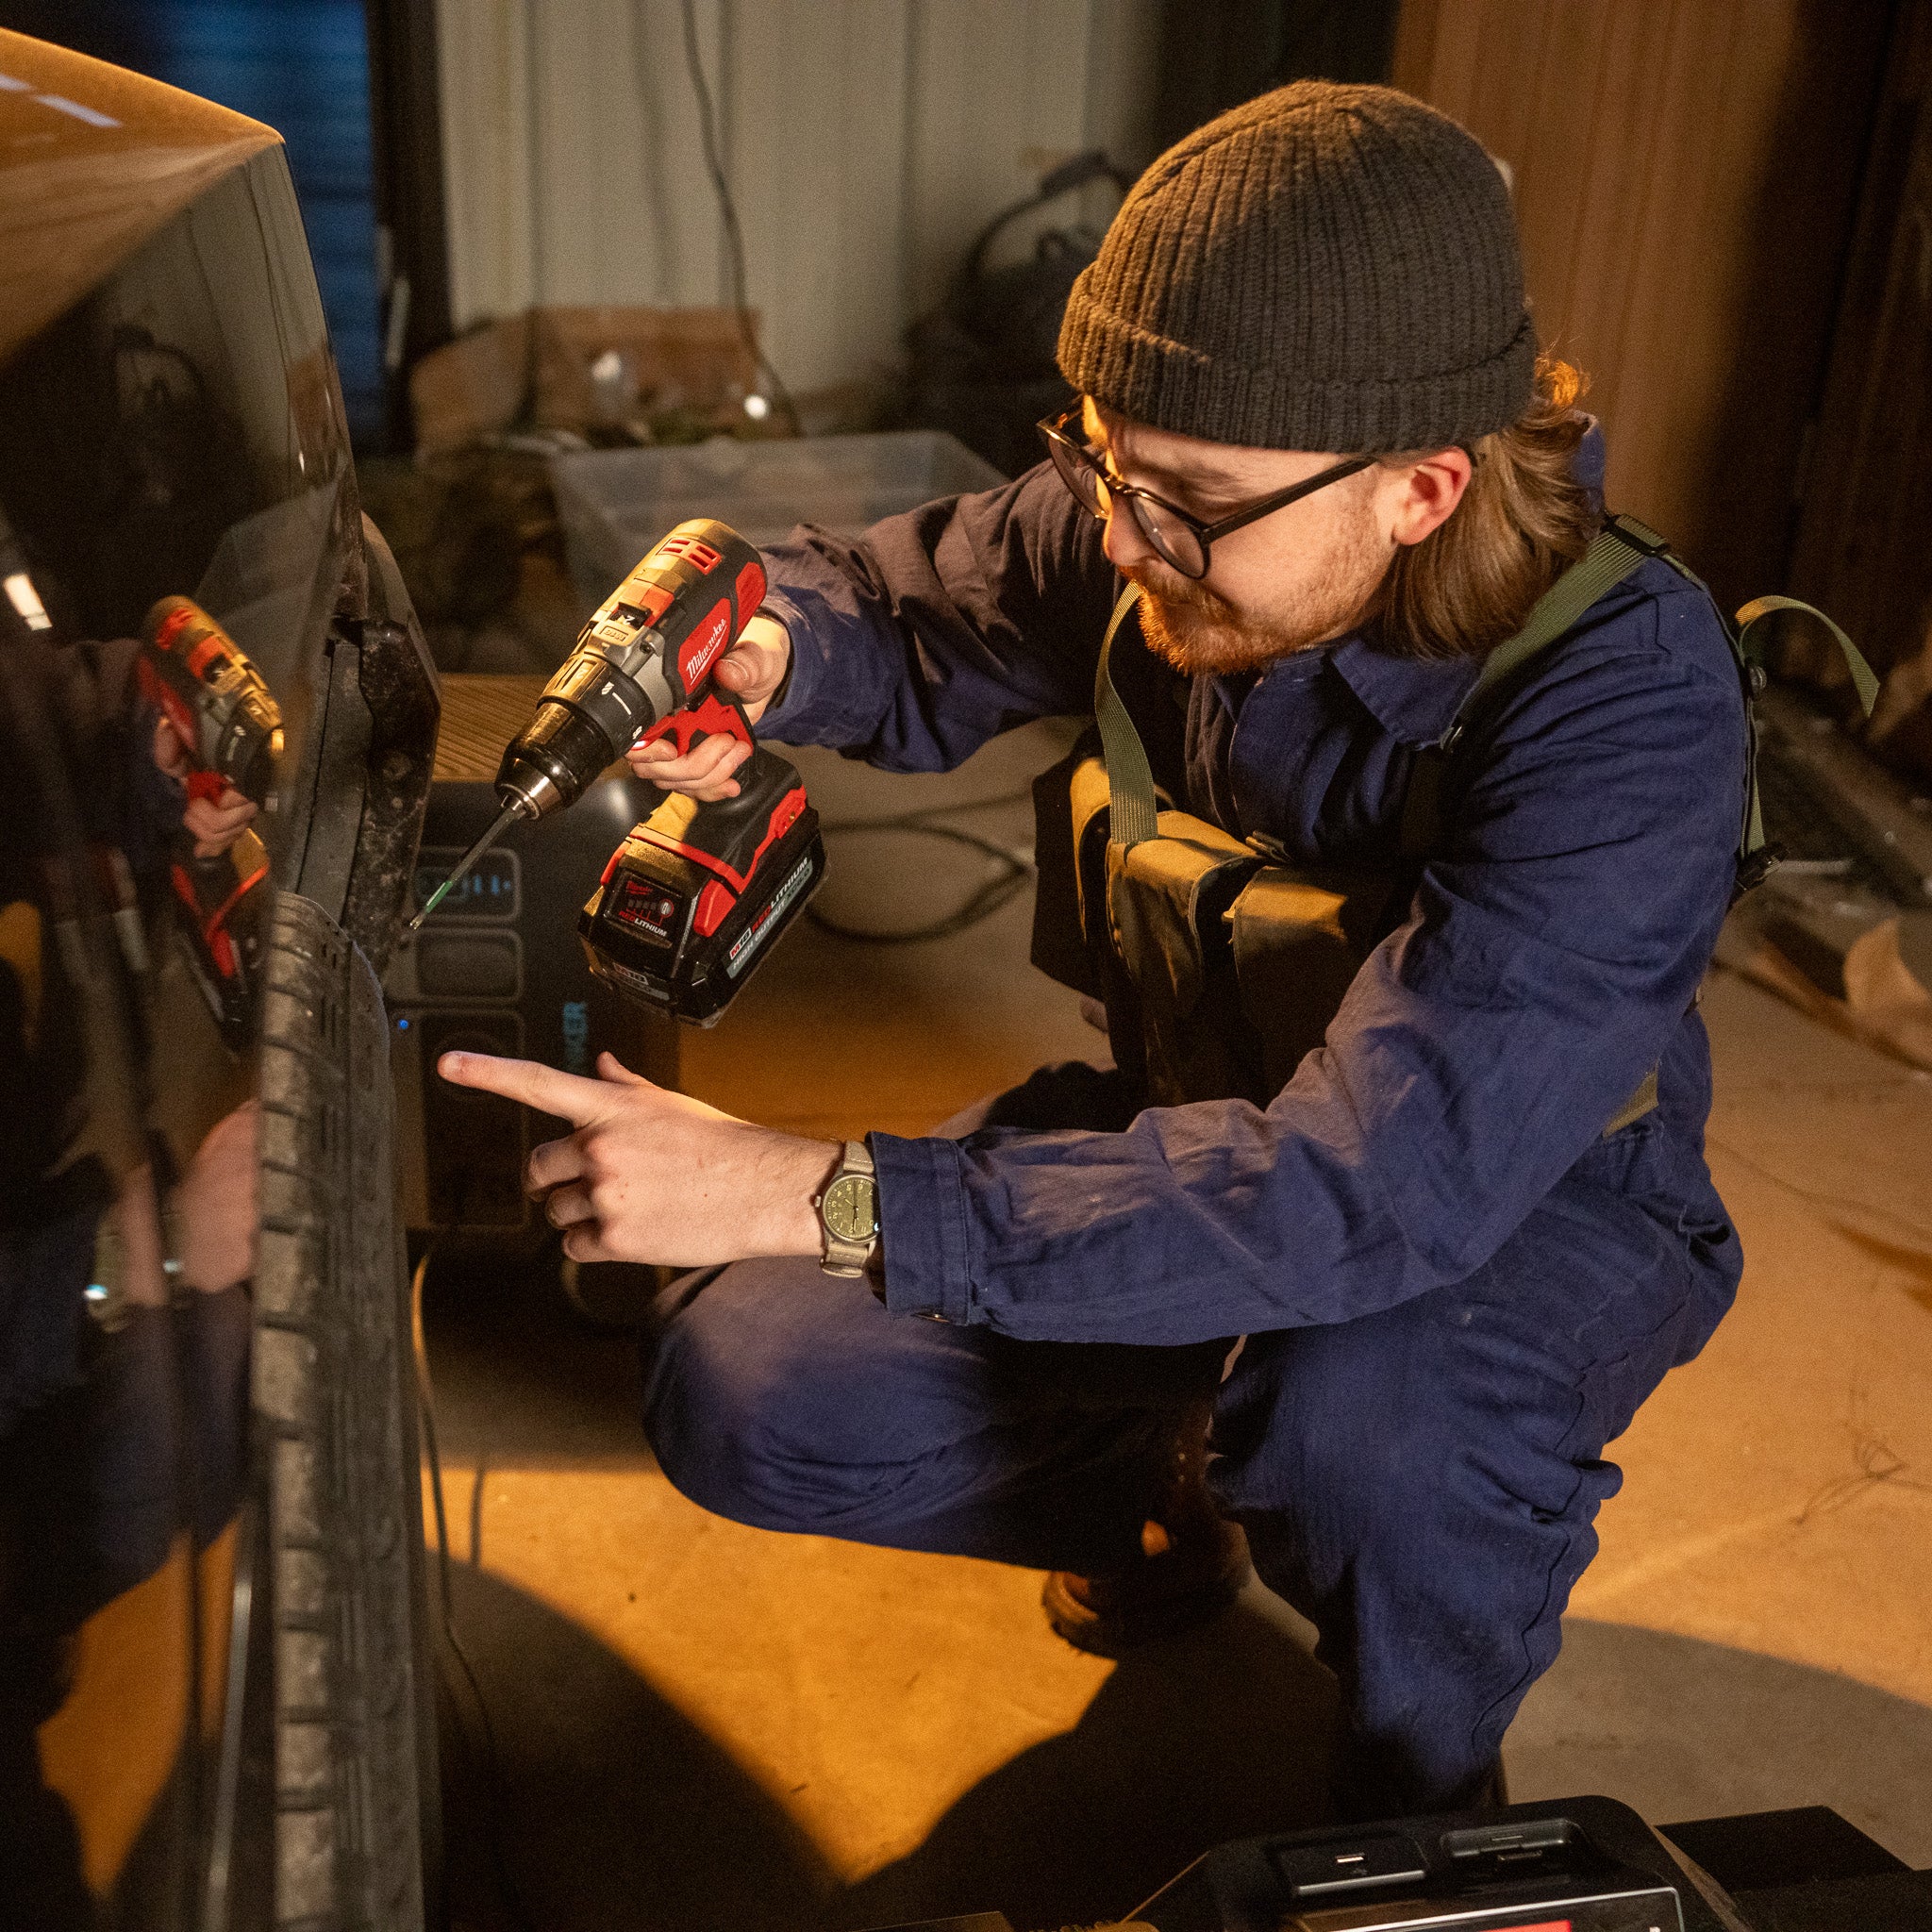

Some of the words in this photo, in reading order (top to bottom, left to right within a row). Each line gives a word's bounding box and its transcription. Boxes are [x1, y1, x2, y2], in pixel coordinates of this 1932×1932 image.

[686, 618, 726, 680] Milwaukee
[619, 910, 668, 937] REDLITHIUM
[730, 929, 751, 958] M18
[752, 857, 808, 933] REDLITHIUM
[733, 940, 754, 970] HIGH
[755, 899, 786, 941] OUTPUT
